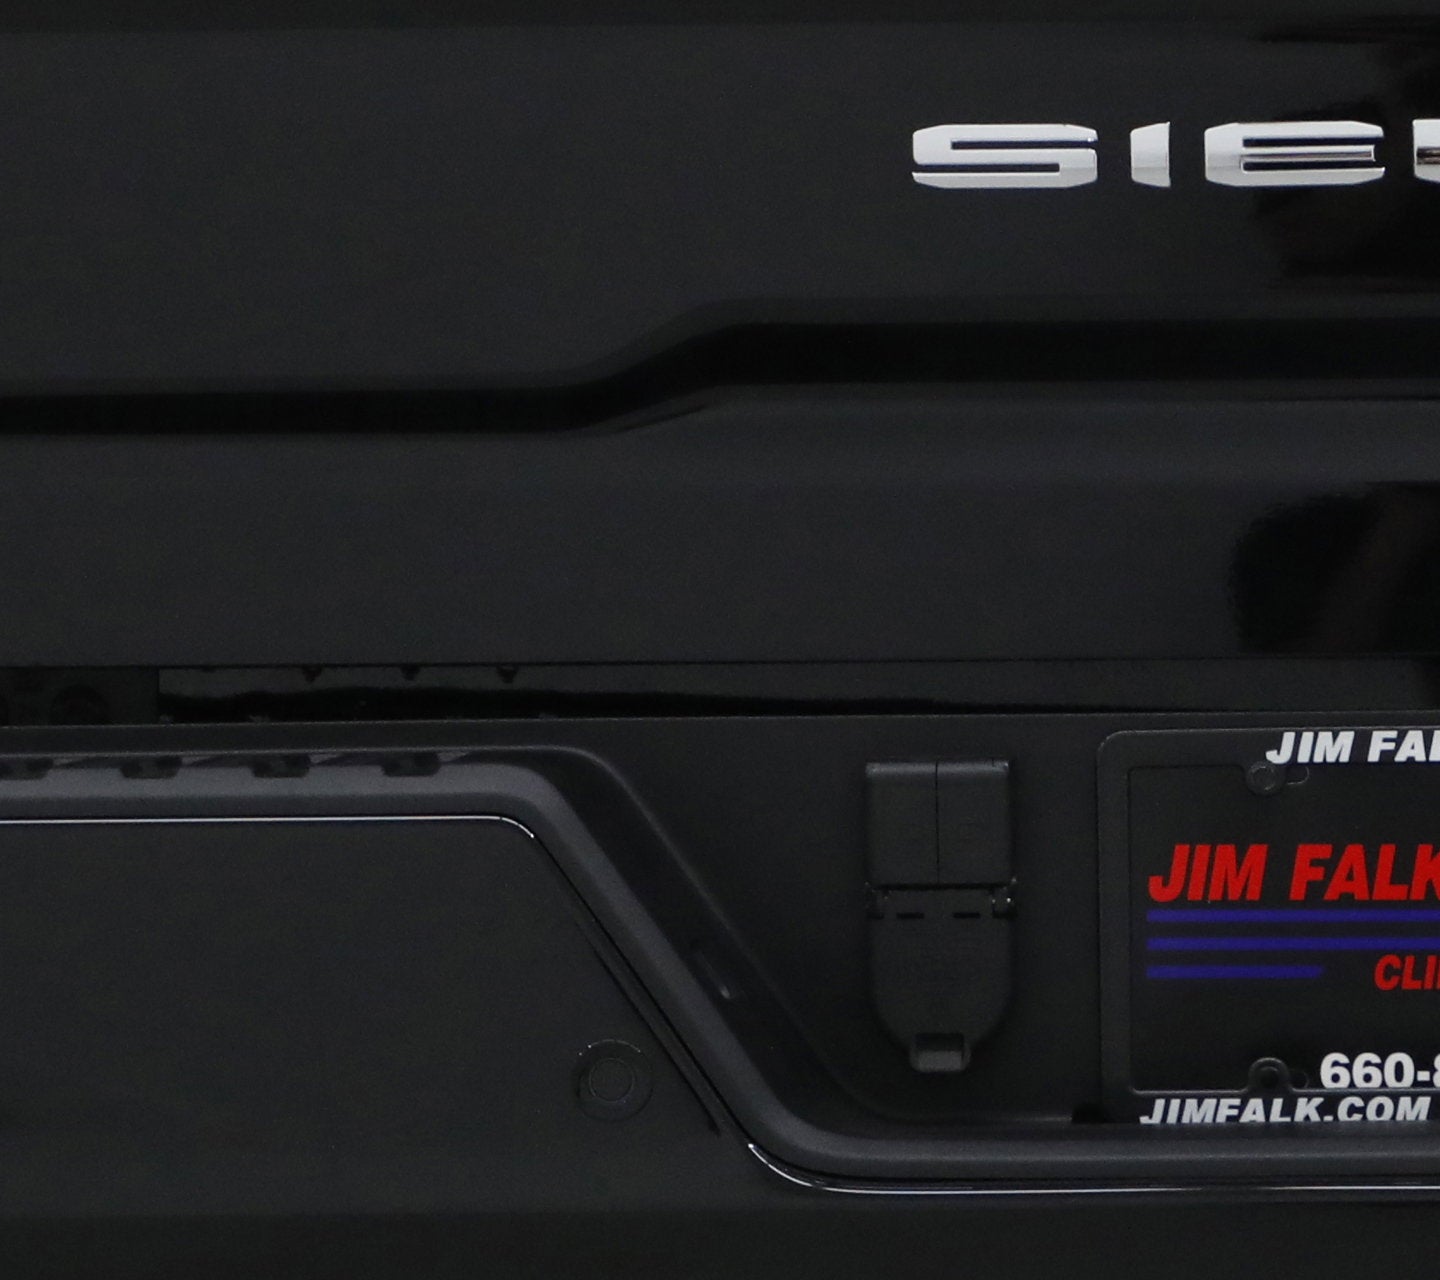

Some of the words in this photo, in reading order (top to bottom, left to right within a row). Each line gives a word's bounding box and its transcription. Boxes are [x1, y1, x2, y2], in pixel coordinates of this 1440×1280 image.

[1266, 730, 1354, 763] JIM
[1148, 844, 1268, 902] JIM
[1139, 1096, 1431, 1124] JIMFALK.COM
